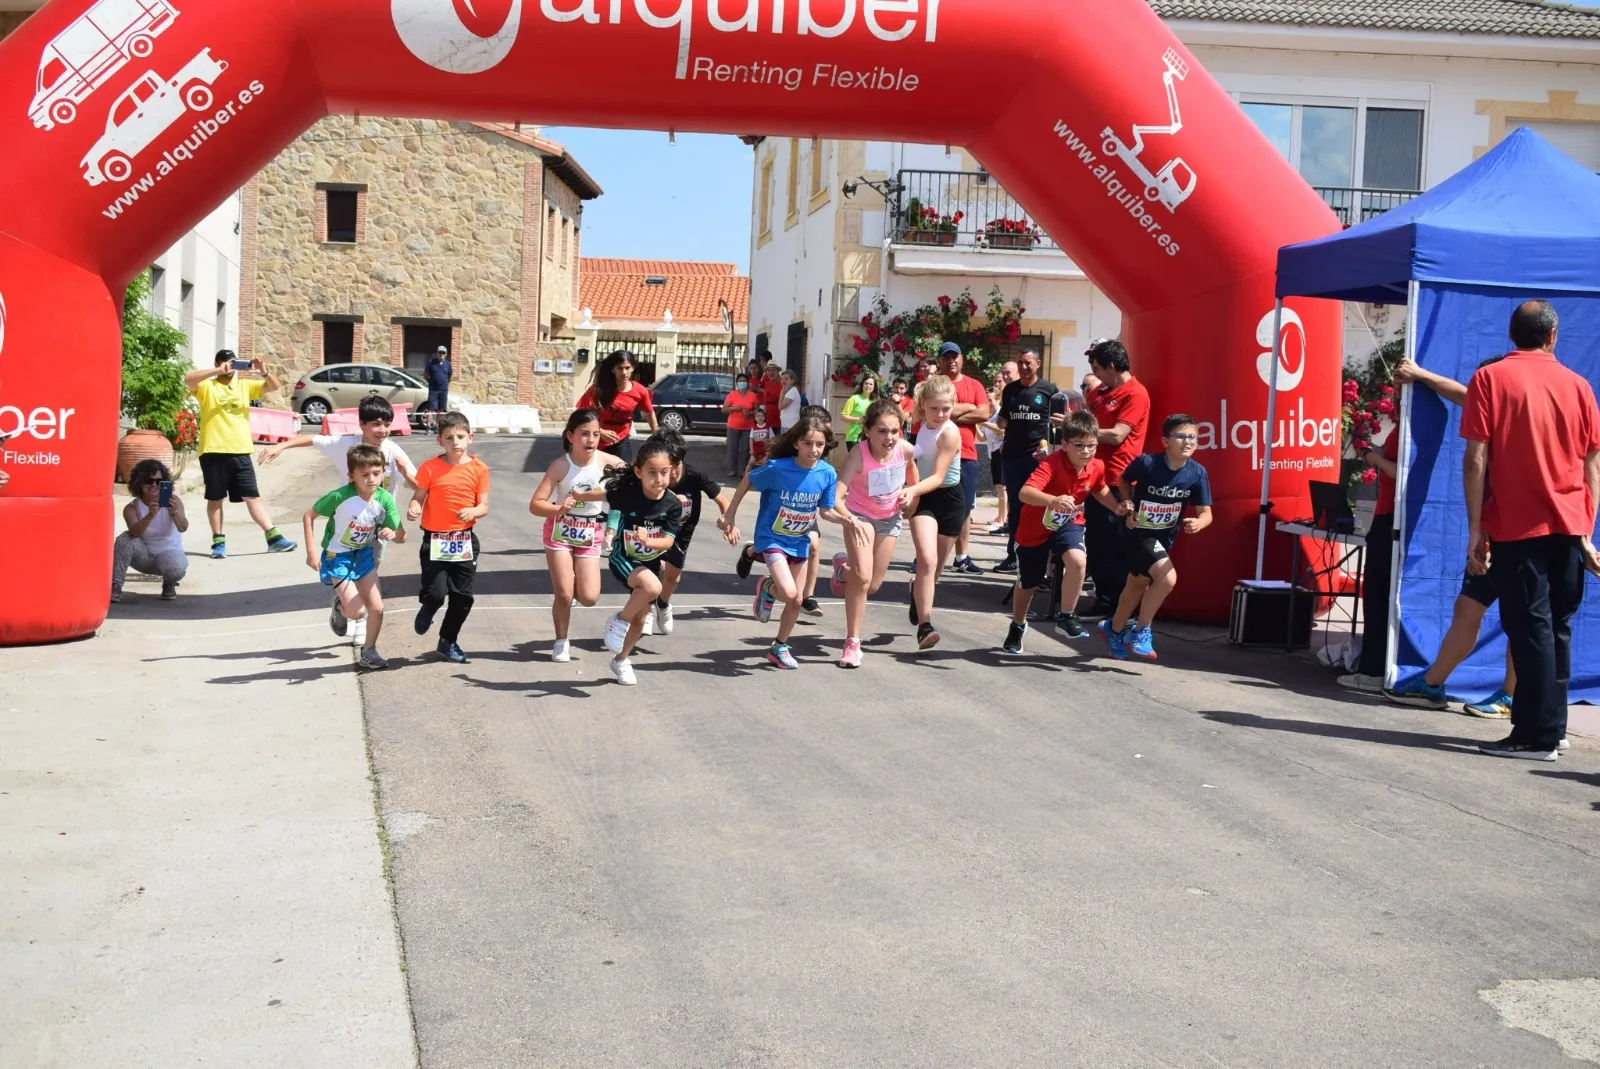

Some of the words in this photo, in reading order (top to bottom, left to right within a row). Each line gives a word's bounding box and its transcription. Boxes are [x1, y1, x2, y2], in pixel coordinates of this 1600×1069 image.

[692, 57, 802, 91] Renting
[812, 63, 919, 92] Flexible
[102, 80, 265, 220] www.alquiber.es
[1053, 119, 1180, 256] www.alquiber.es
[4, 450, 60, 465] Flexible
[1306, 456, 1334, 469] Flexible
[1148, 485, 1191, 498] adidas
[782, 519, 809, 530] 277
[1052, 513, 1072, 524] 27
[1146, 513, 1172, 523] 278
[561, 525, 586, 540] 284
[440, 541, 464, 553] 285
